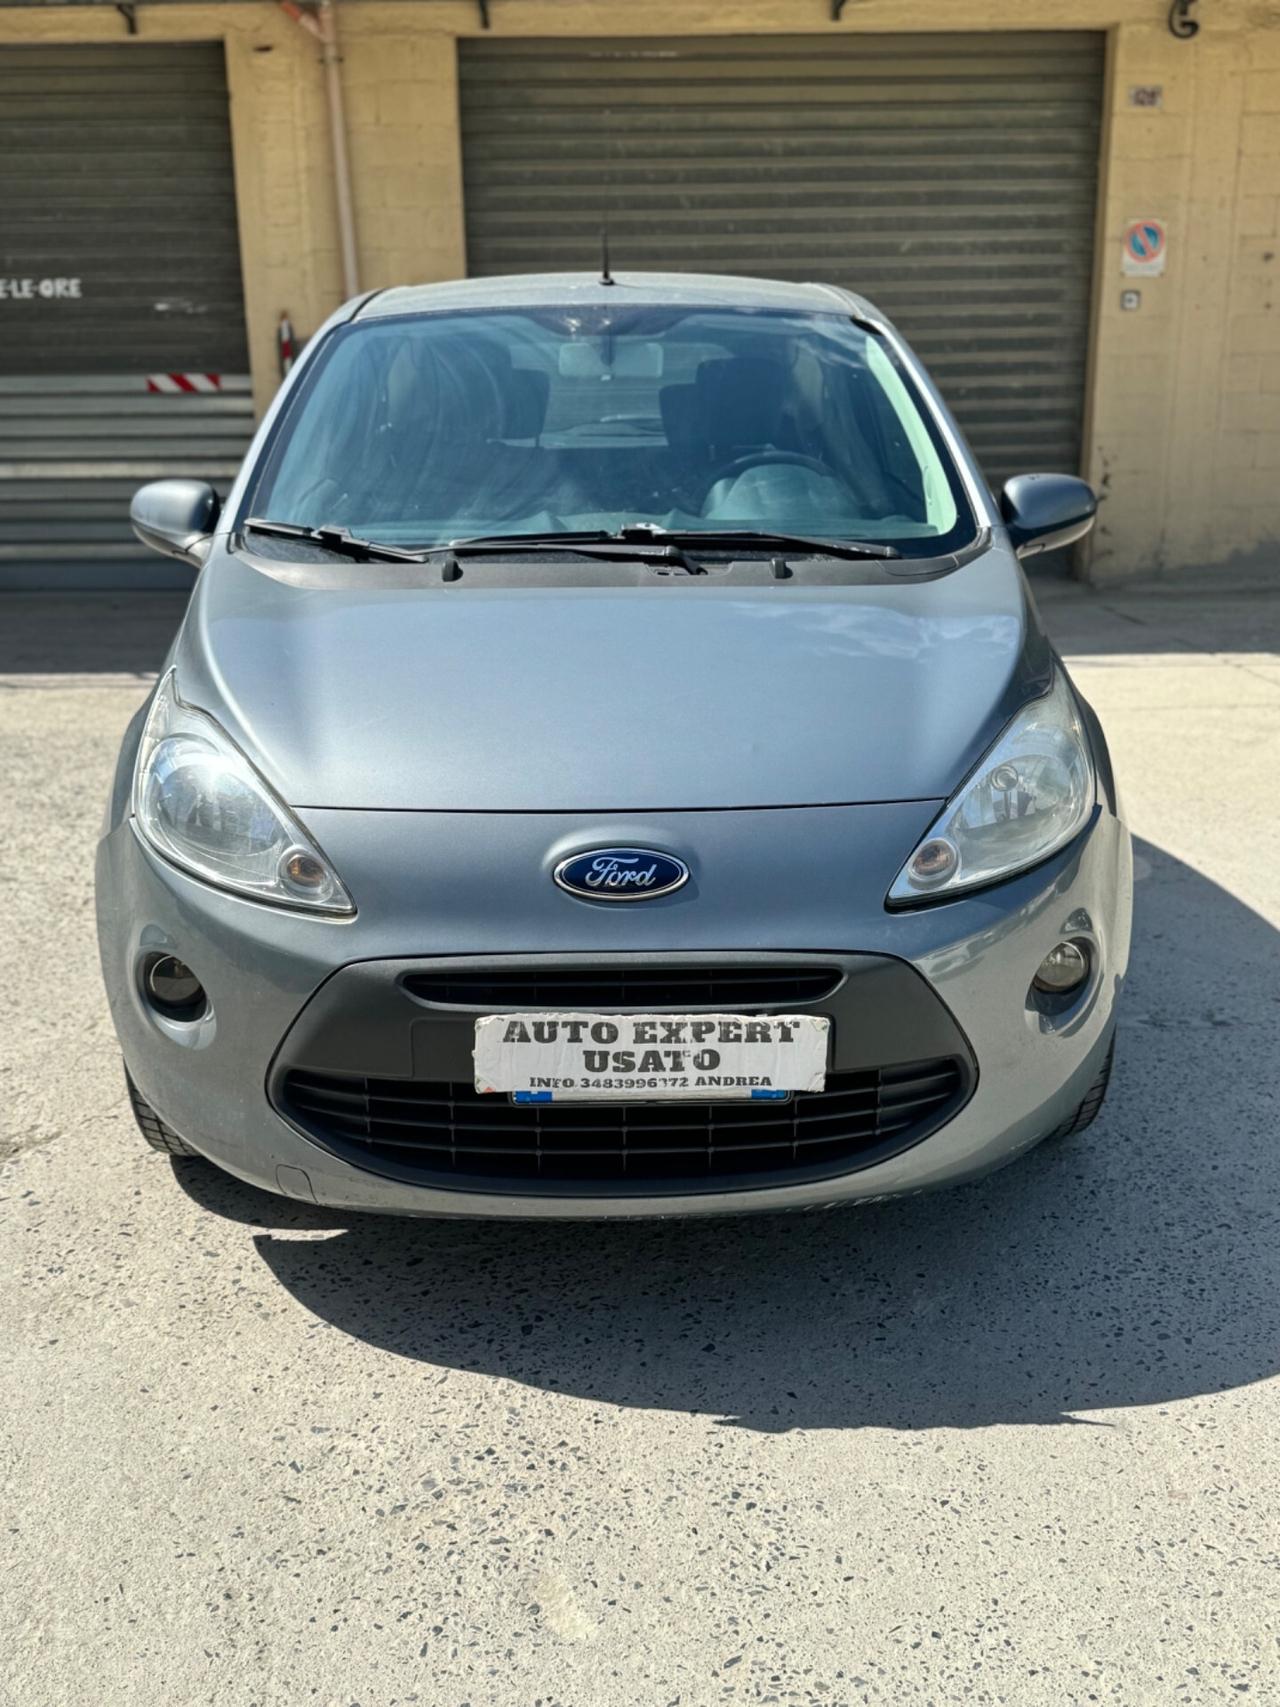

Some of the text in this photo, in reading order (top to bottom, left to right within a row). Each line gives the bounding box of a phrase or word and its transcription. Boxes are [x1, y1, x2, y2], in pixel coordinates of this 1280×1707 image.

[585, 856, 658, 887] Ford
[503, 1019, 800, 1044] AUTO EXPERT
[583, 1049, 721, 1073] USATO
[695, 1076, 772, 1087] ANDREA
